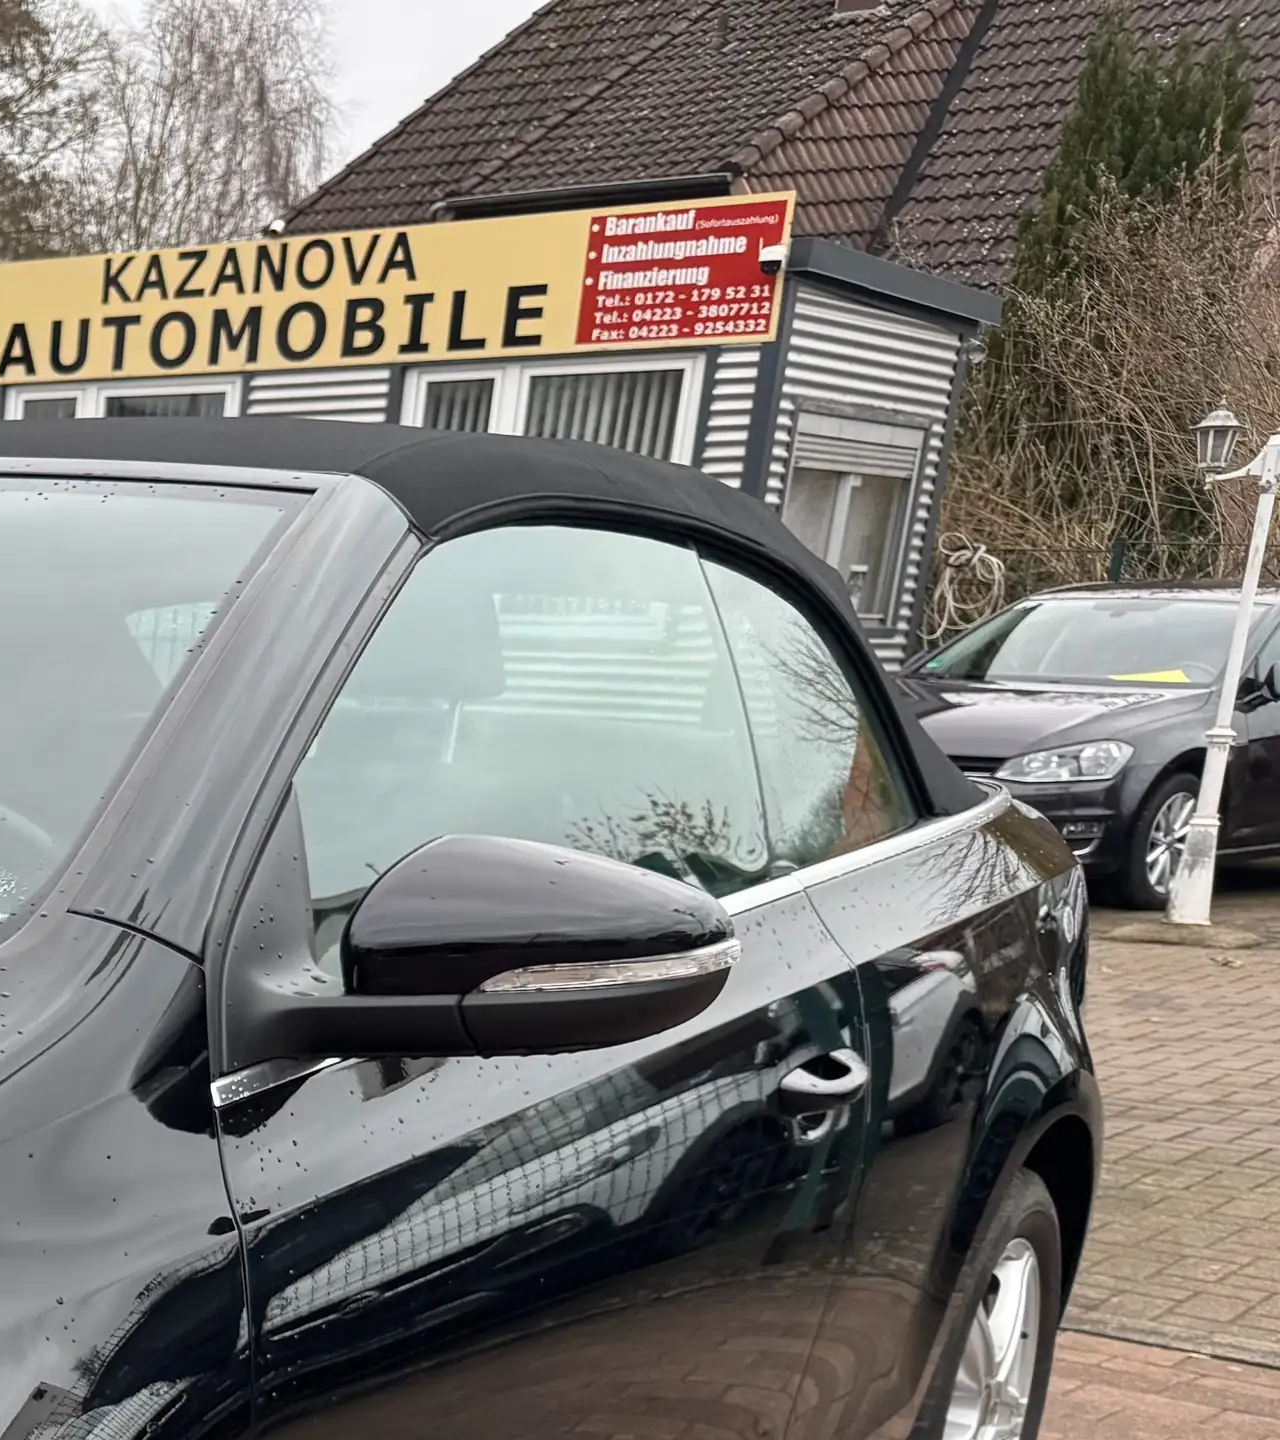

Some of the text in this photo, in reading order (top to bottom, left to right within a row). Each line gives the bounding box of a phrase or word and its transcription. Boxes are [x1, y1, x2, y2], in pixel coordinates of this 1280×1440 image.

[604, 209, 697, 236] Barankauf
[601, 235, 748, 264] Inzahlungnahme
[100, 230, 418, 305] KAZANOVA
[597, 265, 711, 291] Finanzierung
[634, 291, 675, 306] 0172
[690, 287, 721, 302] 179
[725, 286, 747, 300] 52
[749, 284, 771, 298] 31
[631, 307, 683, 323] 04223
[697, 301, 771, 318] 3807712
[628, 323, 680, 339] 04223
[693, 318, 767, 335] 9254332
